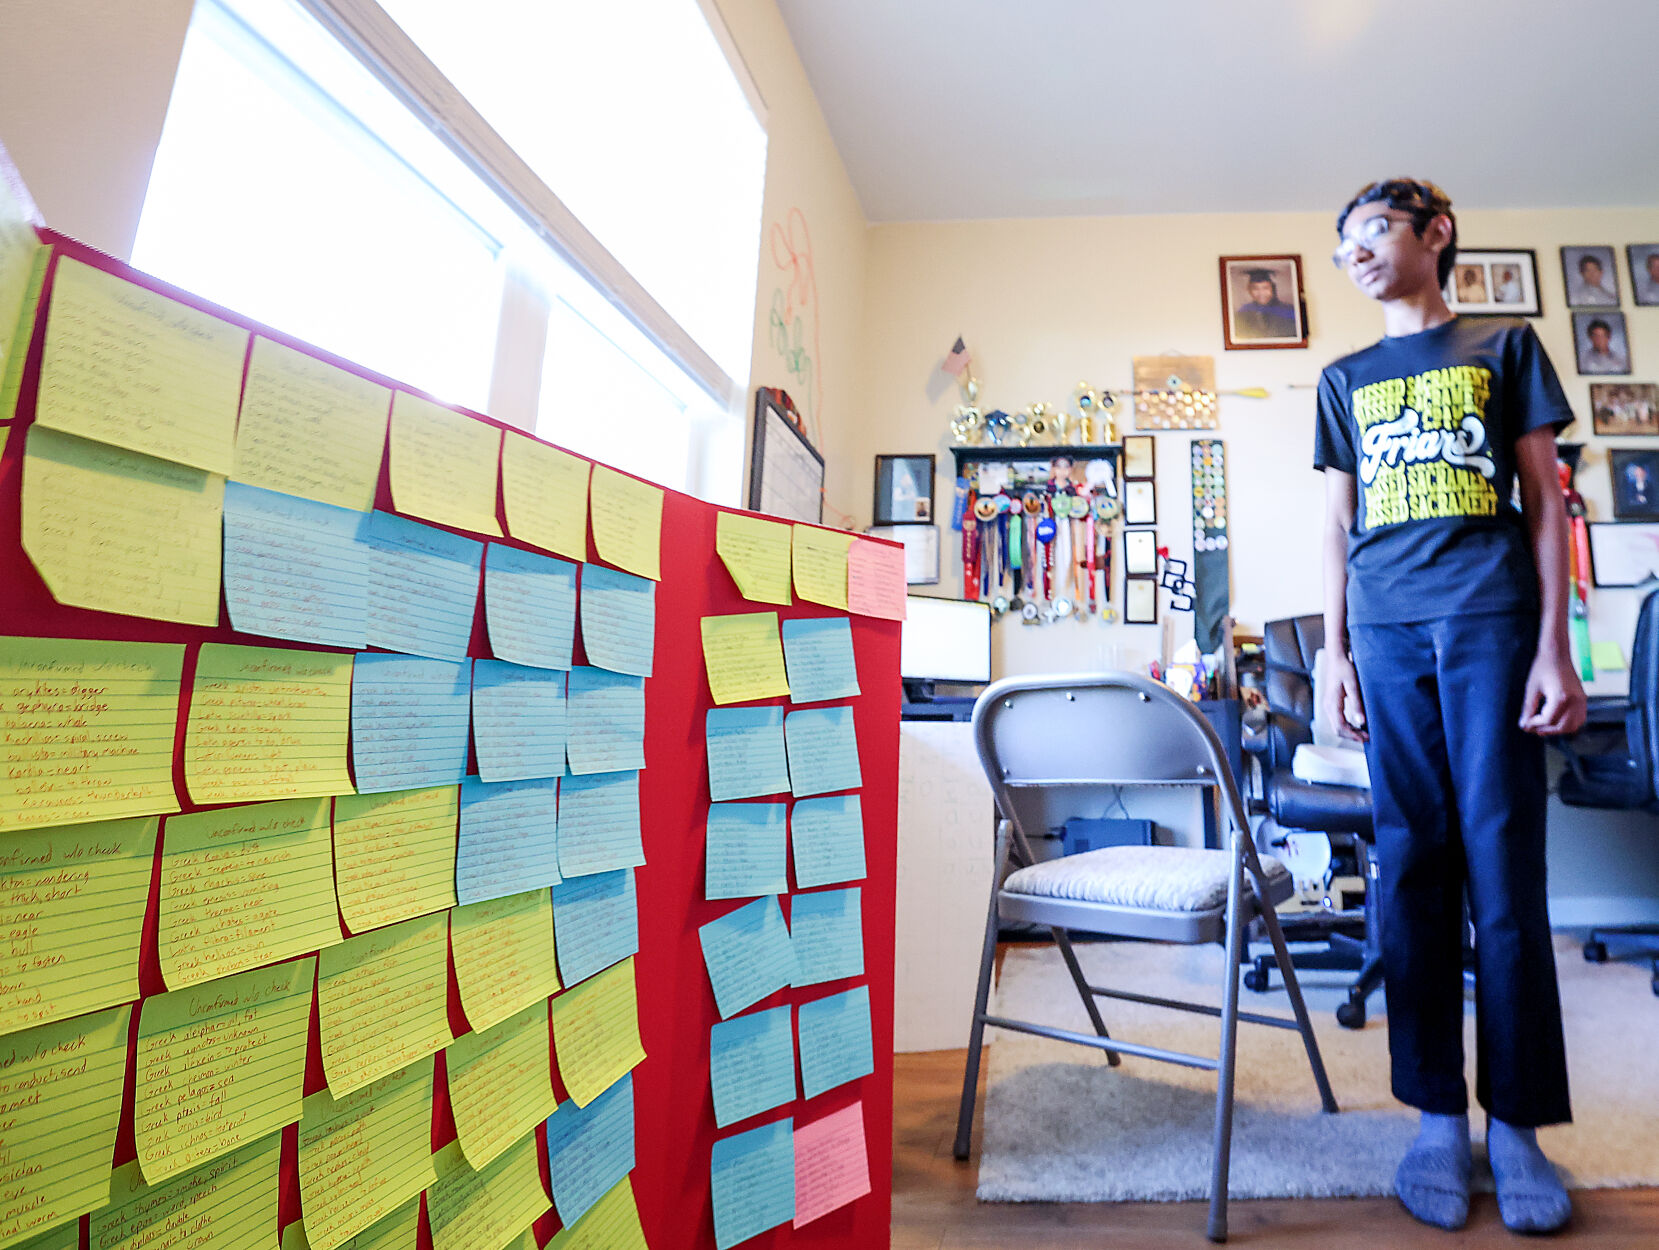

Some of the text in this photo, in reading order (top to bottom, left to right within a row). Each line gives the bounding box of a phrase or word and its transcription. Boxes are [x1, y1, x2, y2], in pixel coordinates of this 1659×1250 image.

[1360, 409, 1496, 484] Friars
[10, 923, 38, 940] eagle
[265, 981, 291, 999] check
[52, 1034, 86, 1055] check
[61, 1057, 87, 1078] send
[144, 1065, 171, 1082] Greek
[210, 1089, 226, 1107] fall
[209, 1158, 239, 1180] spirit
[6, 1196, 46, 1220] muscle
[99, 1226, 126, 1249] Greek
